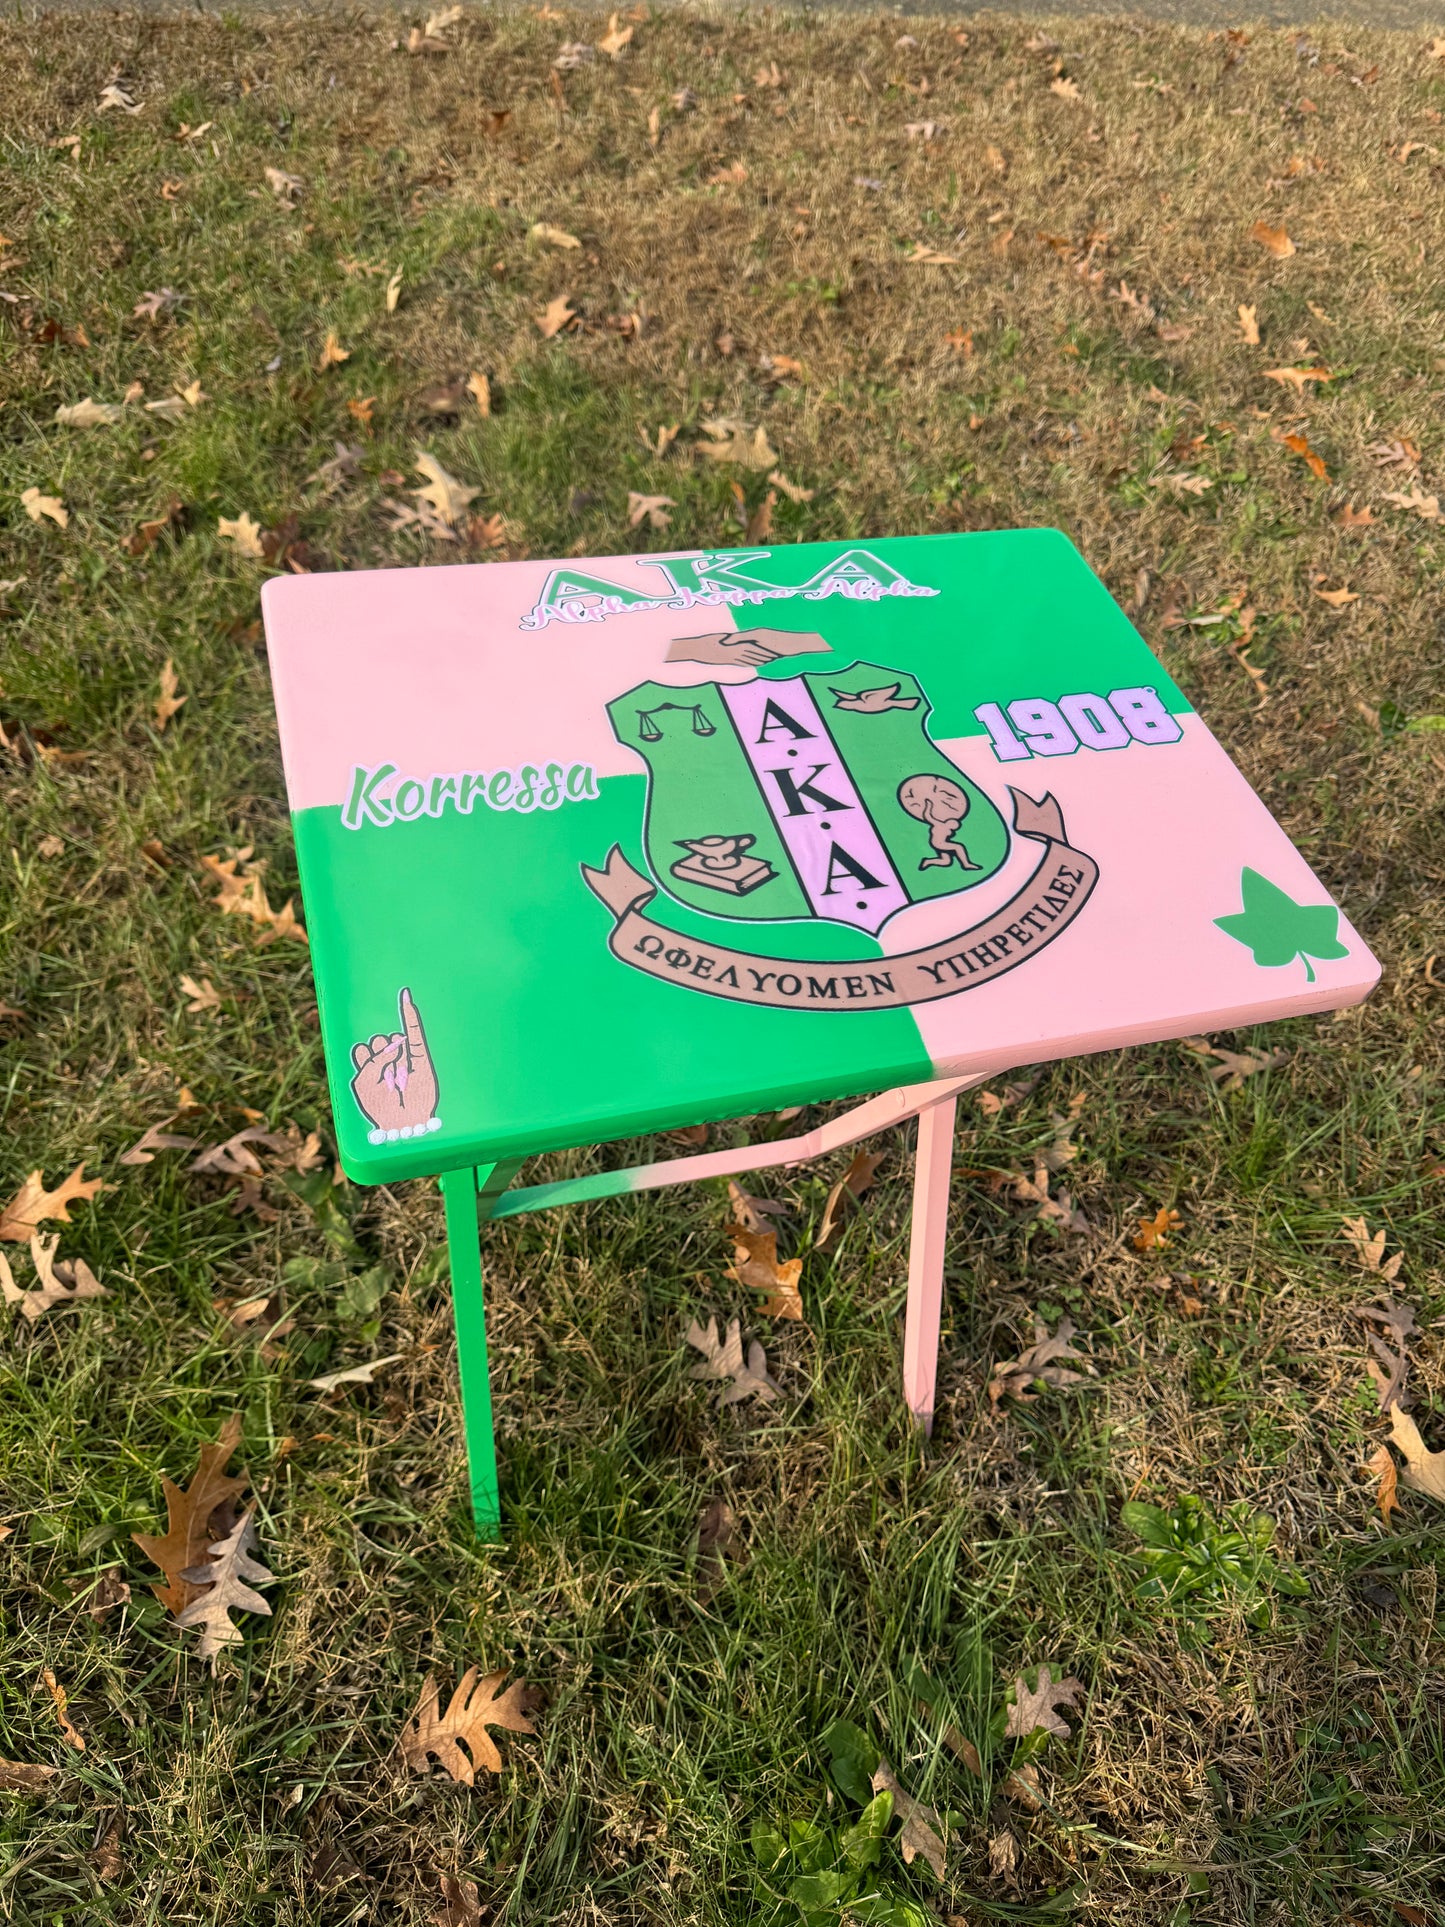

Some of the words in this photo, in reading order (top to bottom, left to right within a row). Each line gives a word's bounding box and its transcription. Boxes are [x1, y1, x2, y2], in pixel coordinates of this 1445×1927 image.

[519, 596, 661, 631] Alpha
[667, 586, 797, 610] Kappa
[802, 579, 942, 601] Alpha
[972, 685, 1184, 763] 1908
[342, 760, 600, 829] Korressa
